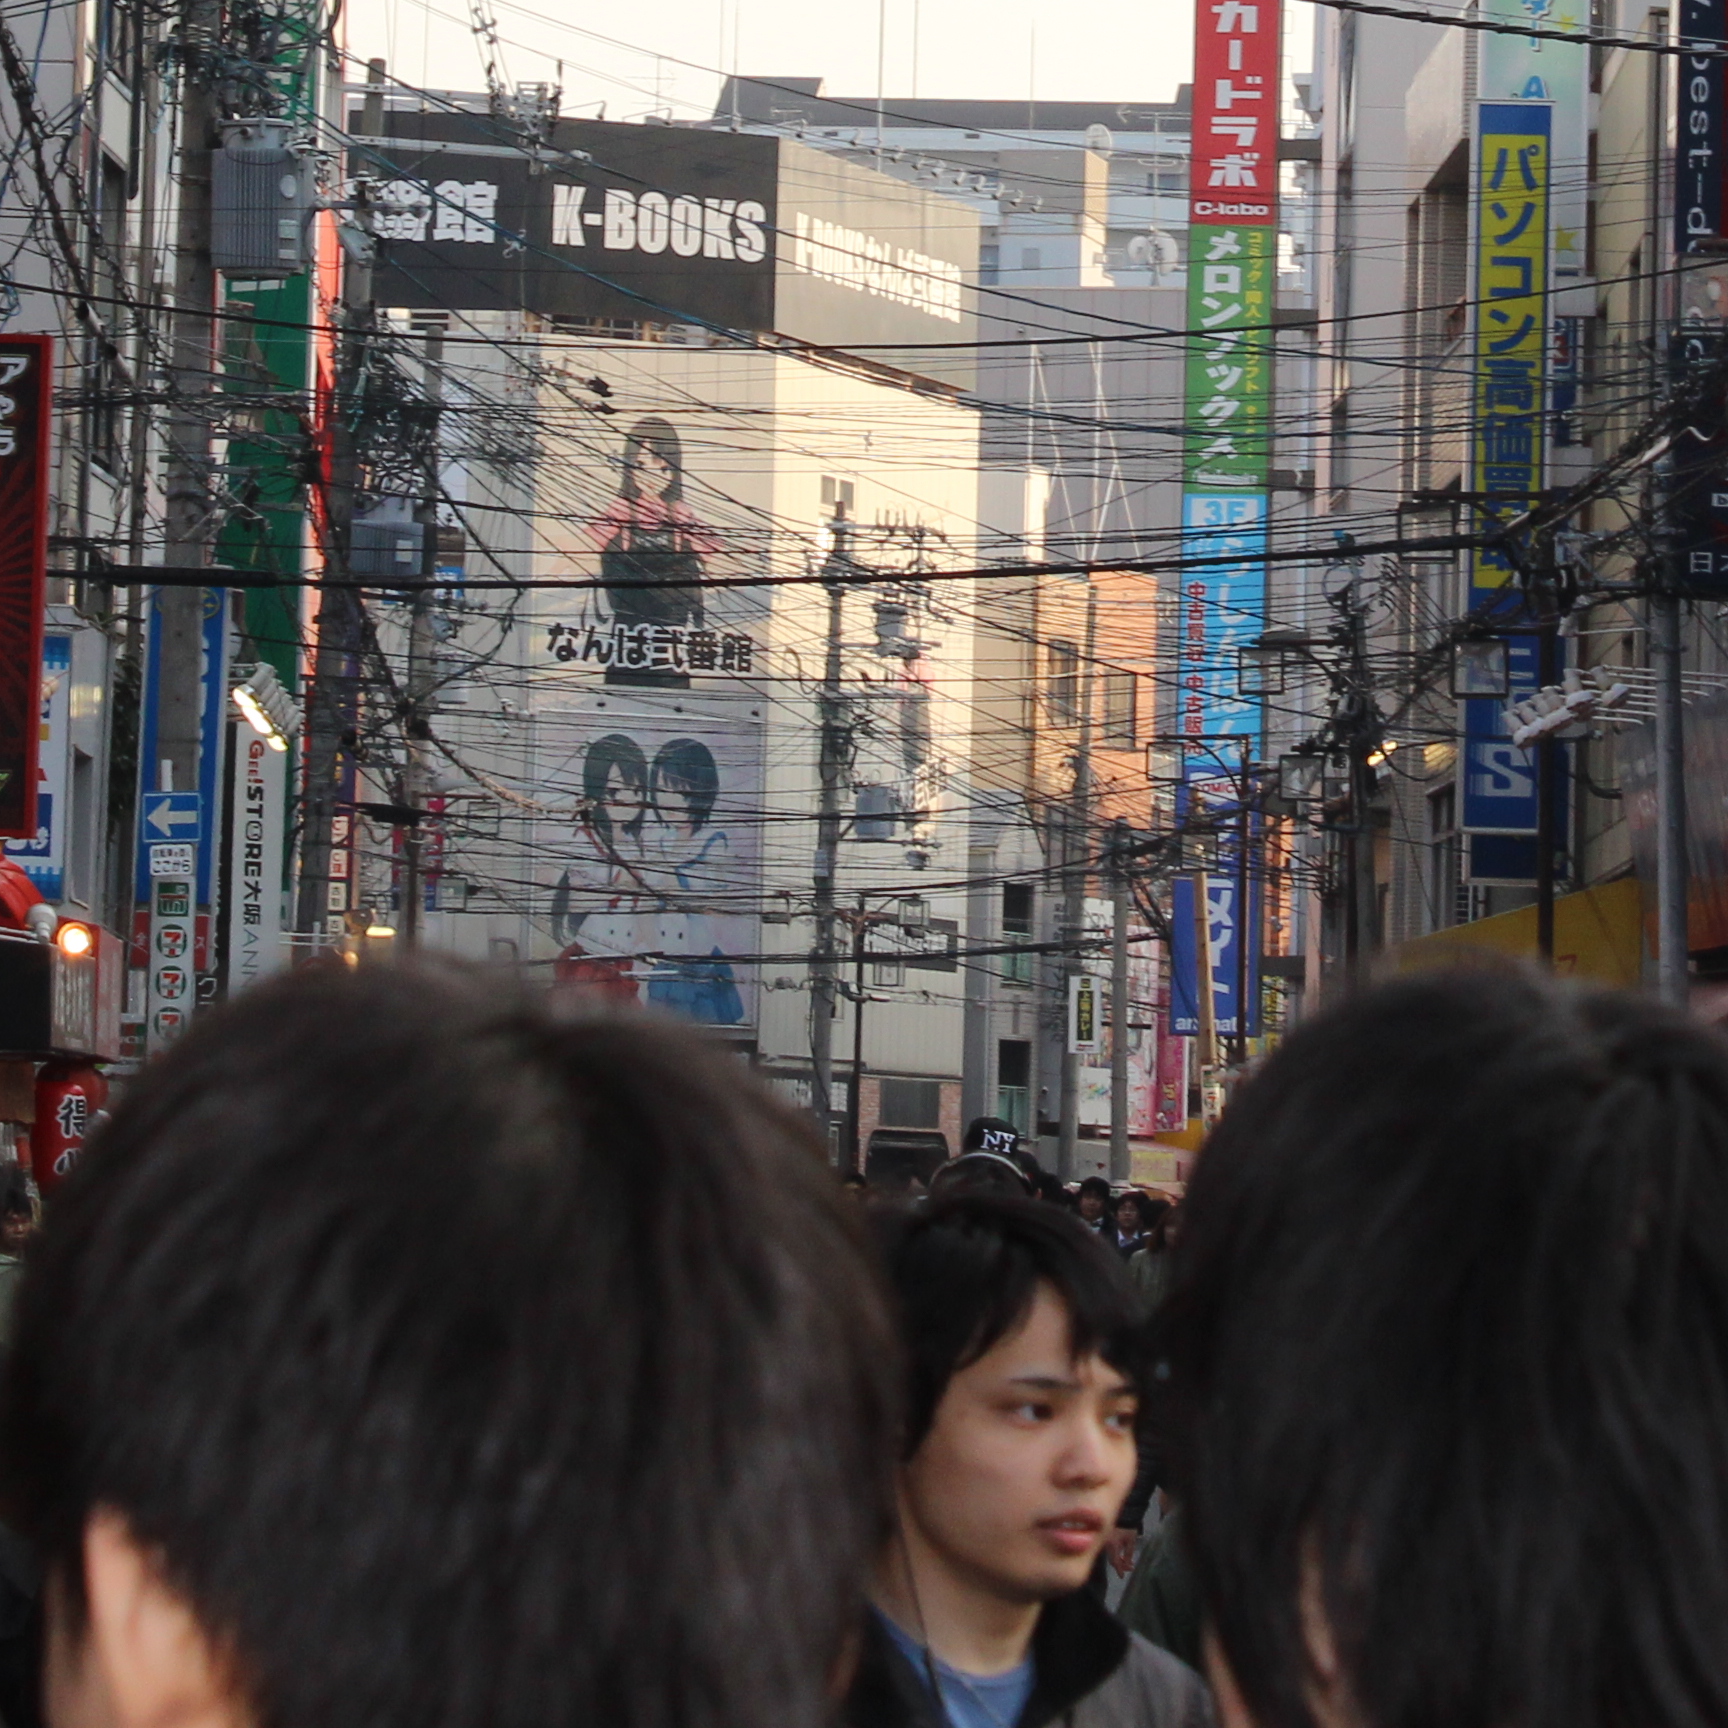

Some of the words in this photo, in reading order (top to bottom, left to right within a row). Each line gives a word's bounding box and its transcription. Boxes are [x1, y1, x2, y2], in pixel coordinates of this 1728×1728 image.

[1208, 0, 1264, 188] カードラボ
[552, 183, 766, 263] K-BOOKS
[1194, 201, 1270, 216] C-labo
[1198, 229, 1244, 460] メロンブックス
[1203, 500, 1247, 524] 3F
[980, 1129, 1016, 1154] NY
